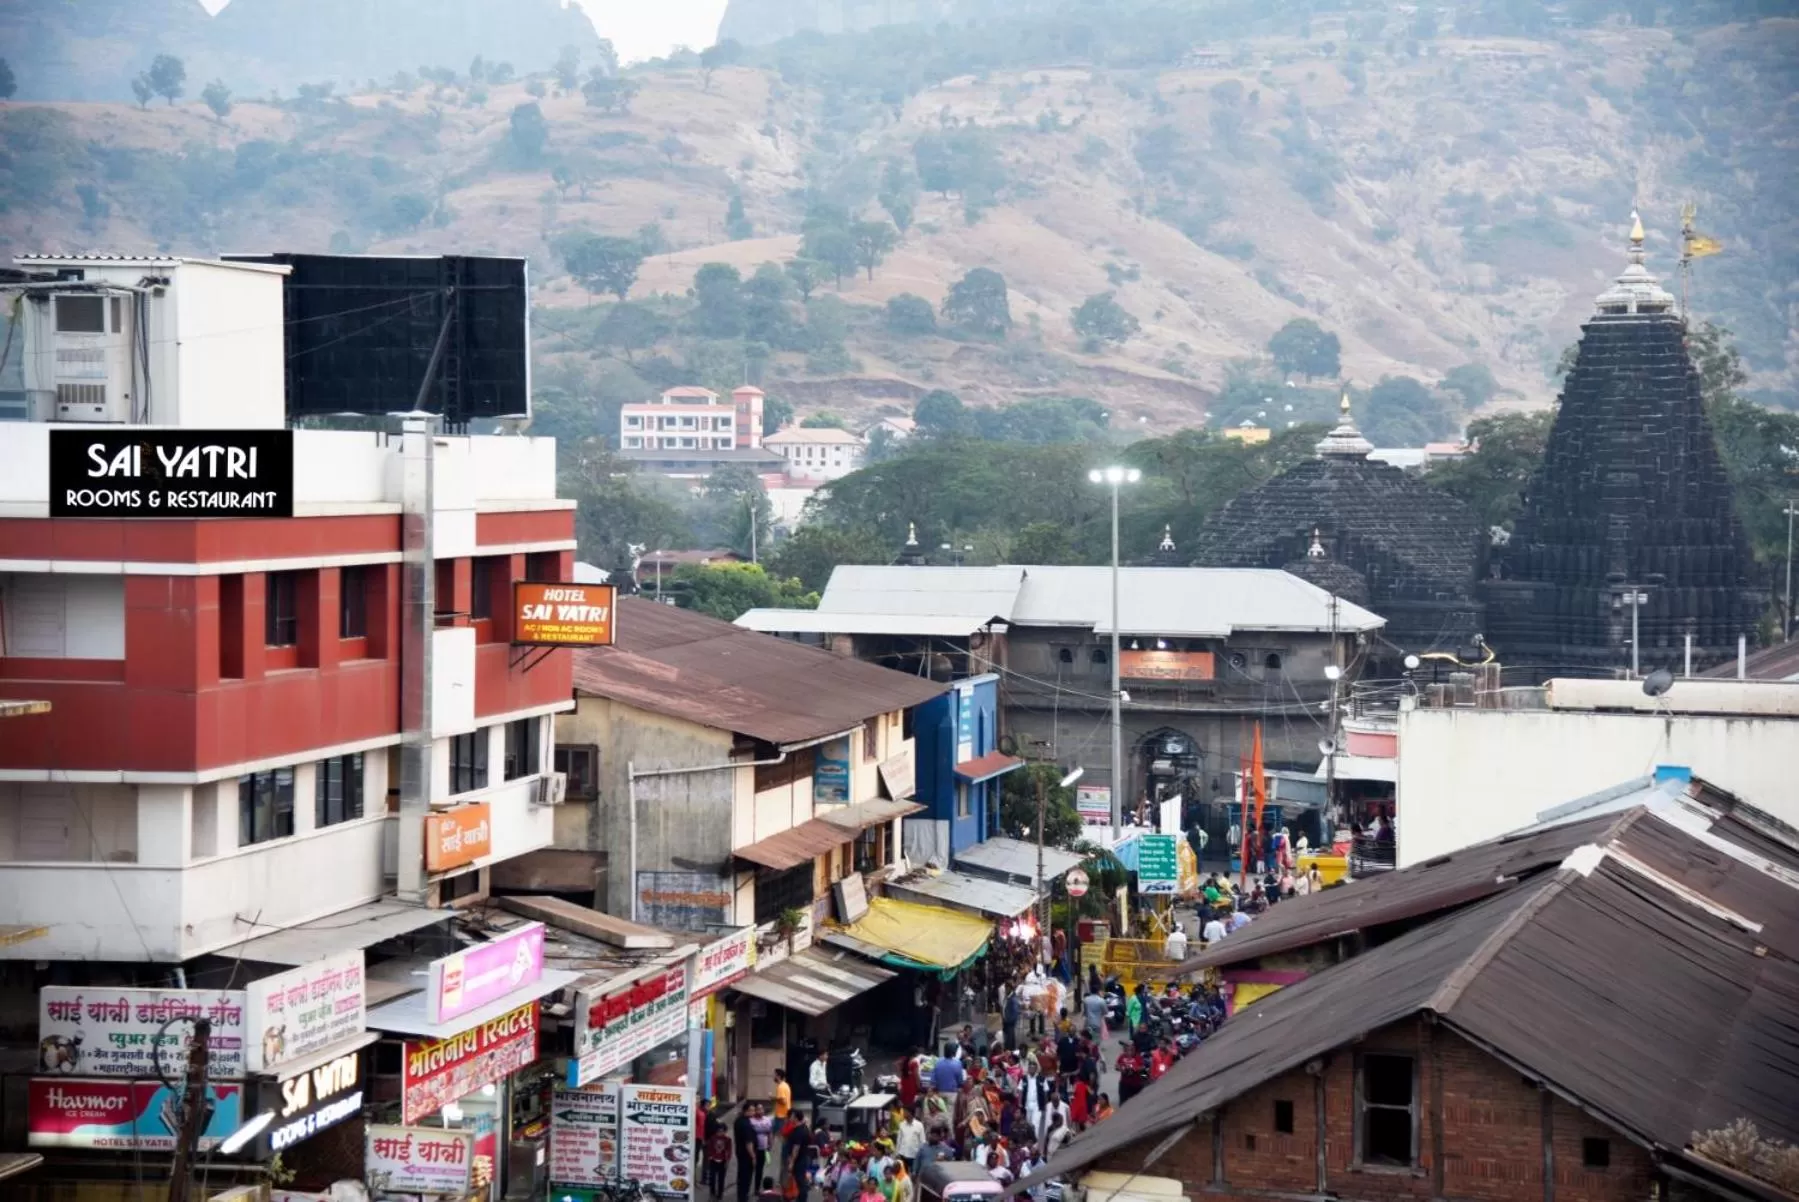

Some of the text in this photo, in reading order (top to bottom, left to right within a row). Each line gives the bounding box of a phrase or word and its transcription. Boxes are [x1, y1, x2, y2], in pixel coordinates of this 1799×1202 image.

[87, 443, 258, 479] SAI YATRI
[66, 489, 278, 509] ROOMS & RESTAURANT
[543, 588, 586, 602] HOTEL
[521, 603, 609, 623] SAI YATRI
[48, 995, 84, 1026] साई
[86, 998, 130, 1024] यात्री
[208, 999, 242, 1028] हॉल
[46, 1088, 128, 1110] Havmor
[626, 1098, 689, 1114] भोजनालय
[93, 1138, 173, 1147] HOTEL SAI YATRI
[374, 1133, 465, 1164] साई यात्री
